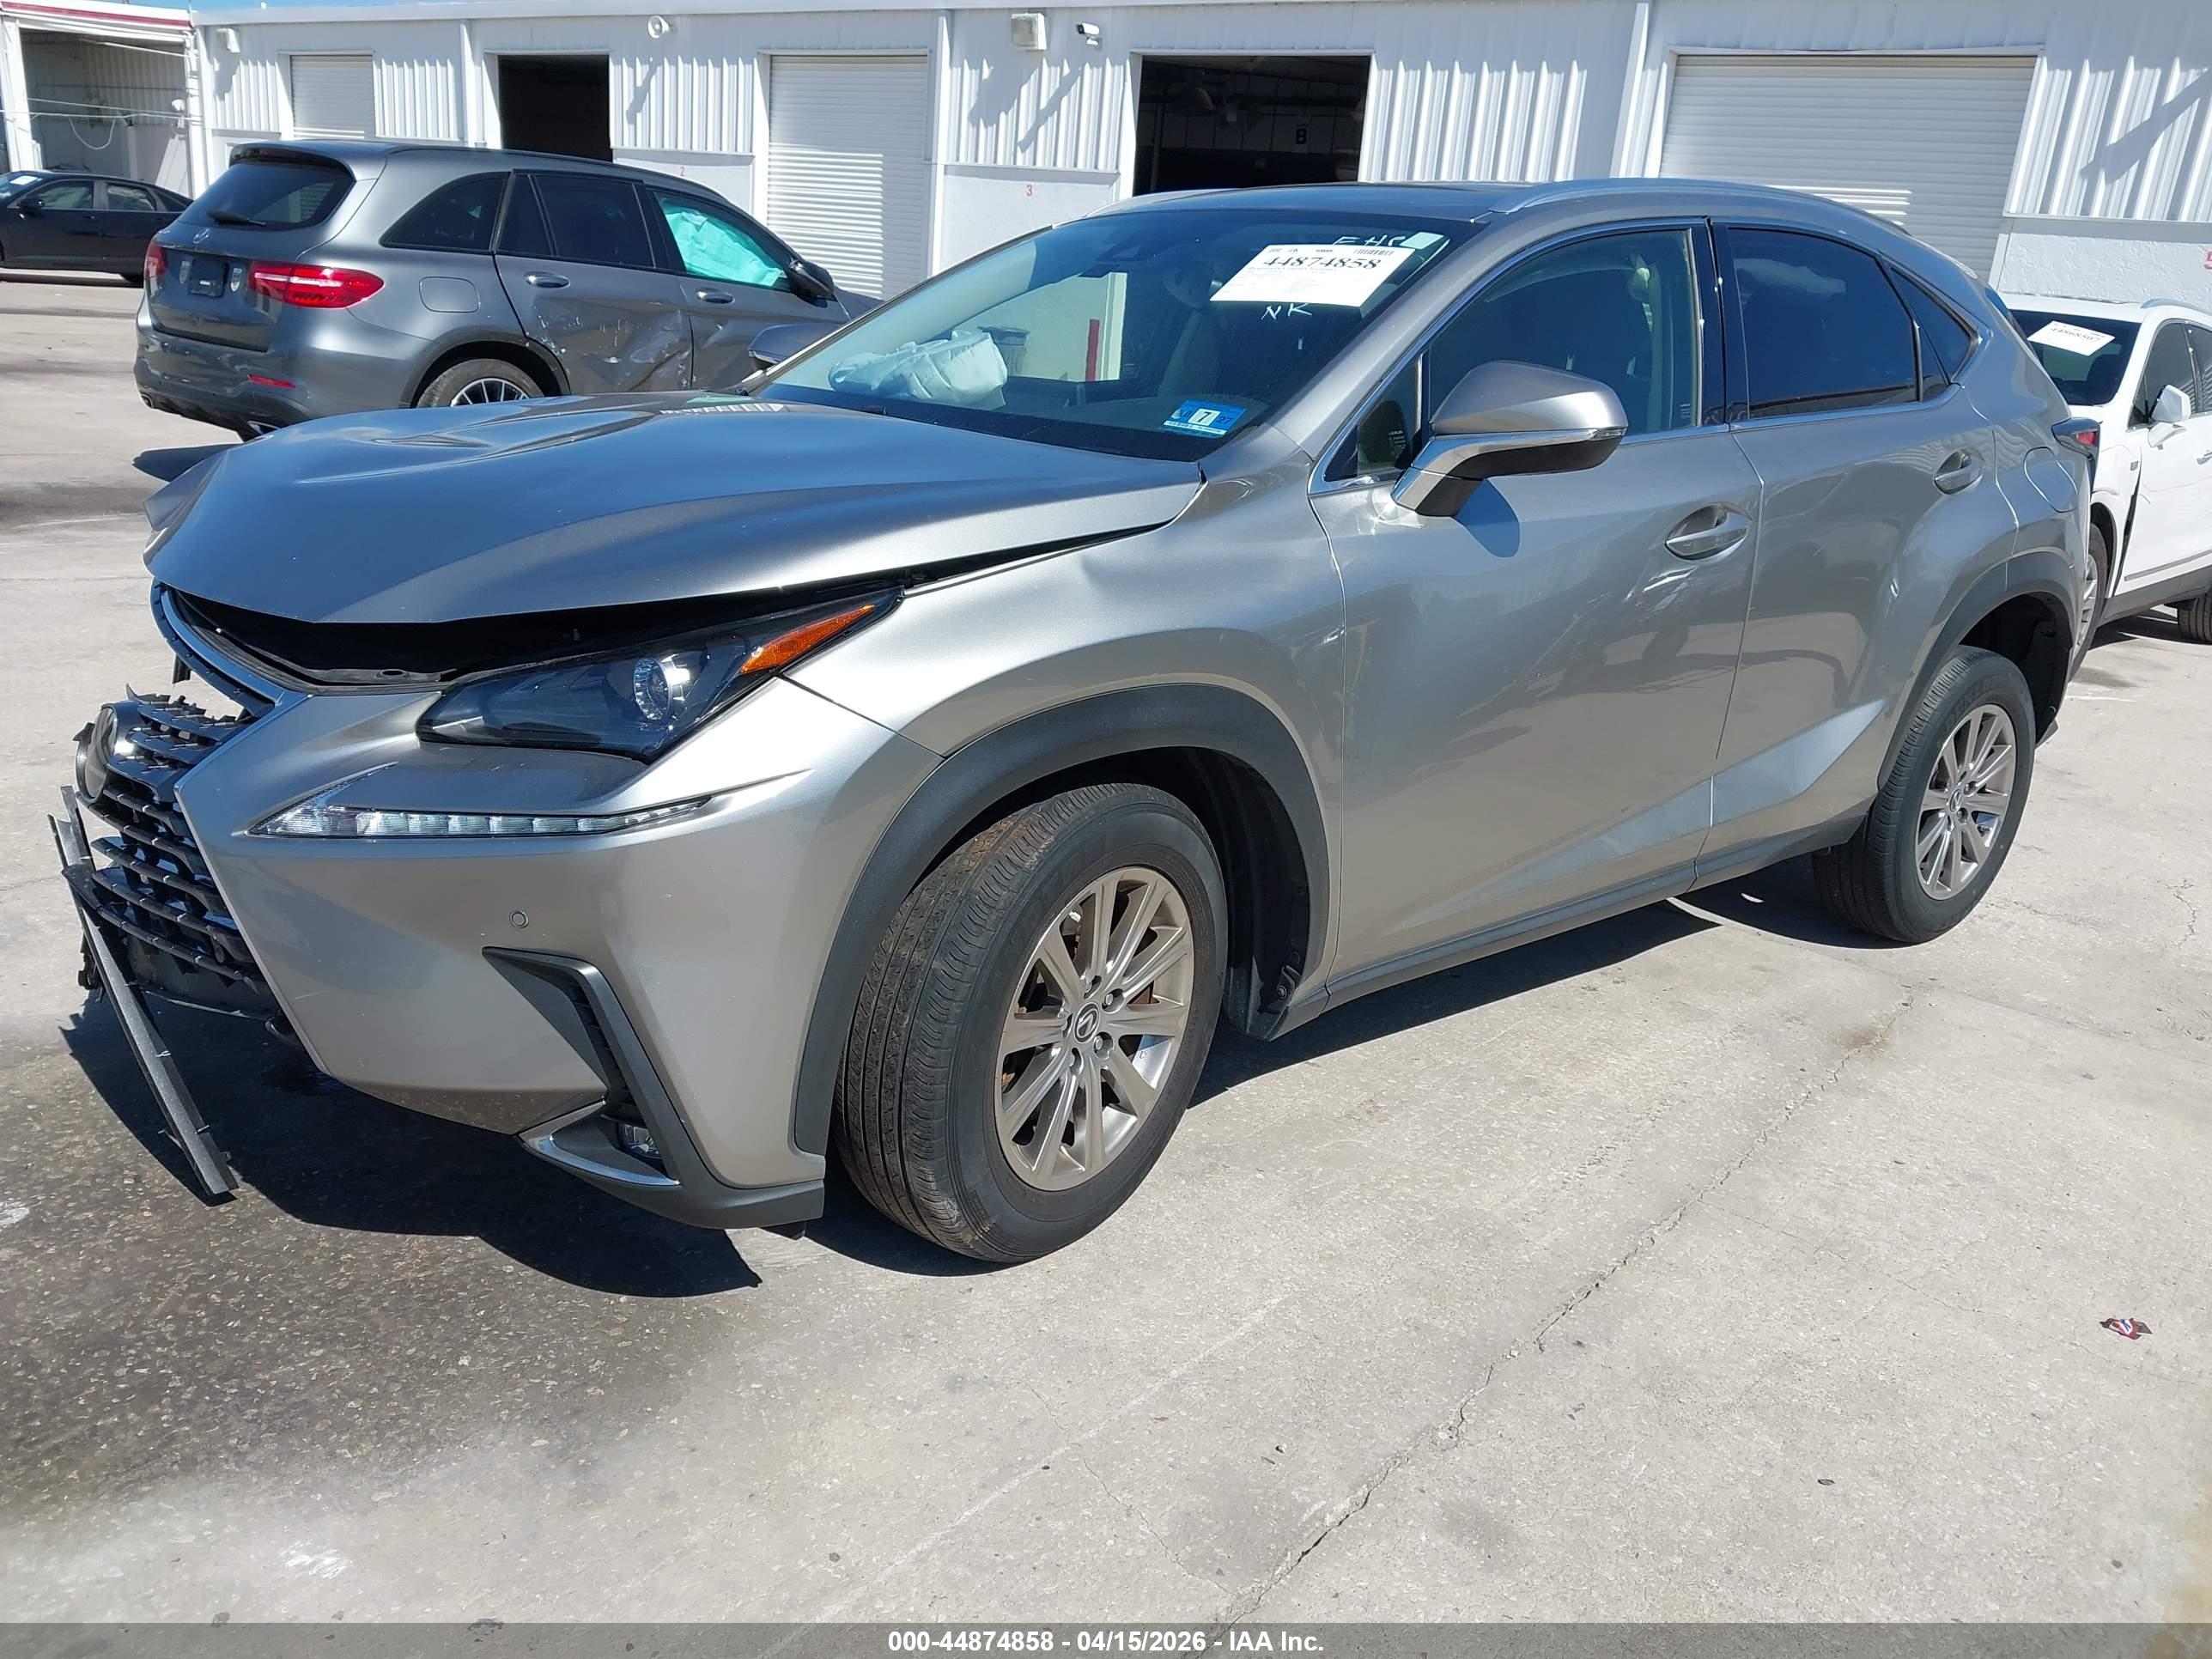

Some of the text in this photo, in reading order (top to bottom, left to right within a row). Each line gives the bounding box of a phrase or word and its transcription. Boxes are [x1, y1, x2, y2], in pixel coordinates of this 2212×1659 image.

[1296, 128, 1307, 144] B
[1026, 184, 1033, 197] 3
[1263, 256, 1382, 269] 44874858
[1197, 410, 1212, 423] 7
[1216, 416, 1234, 425] 27
